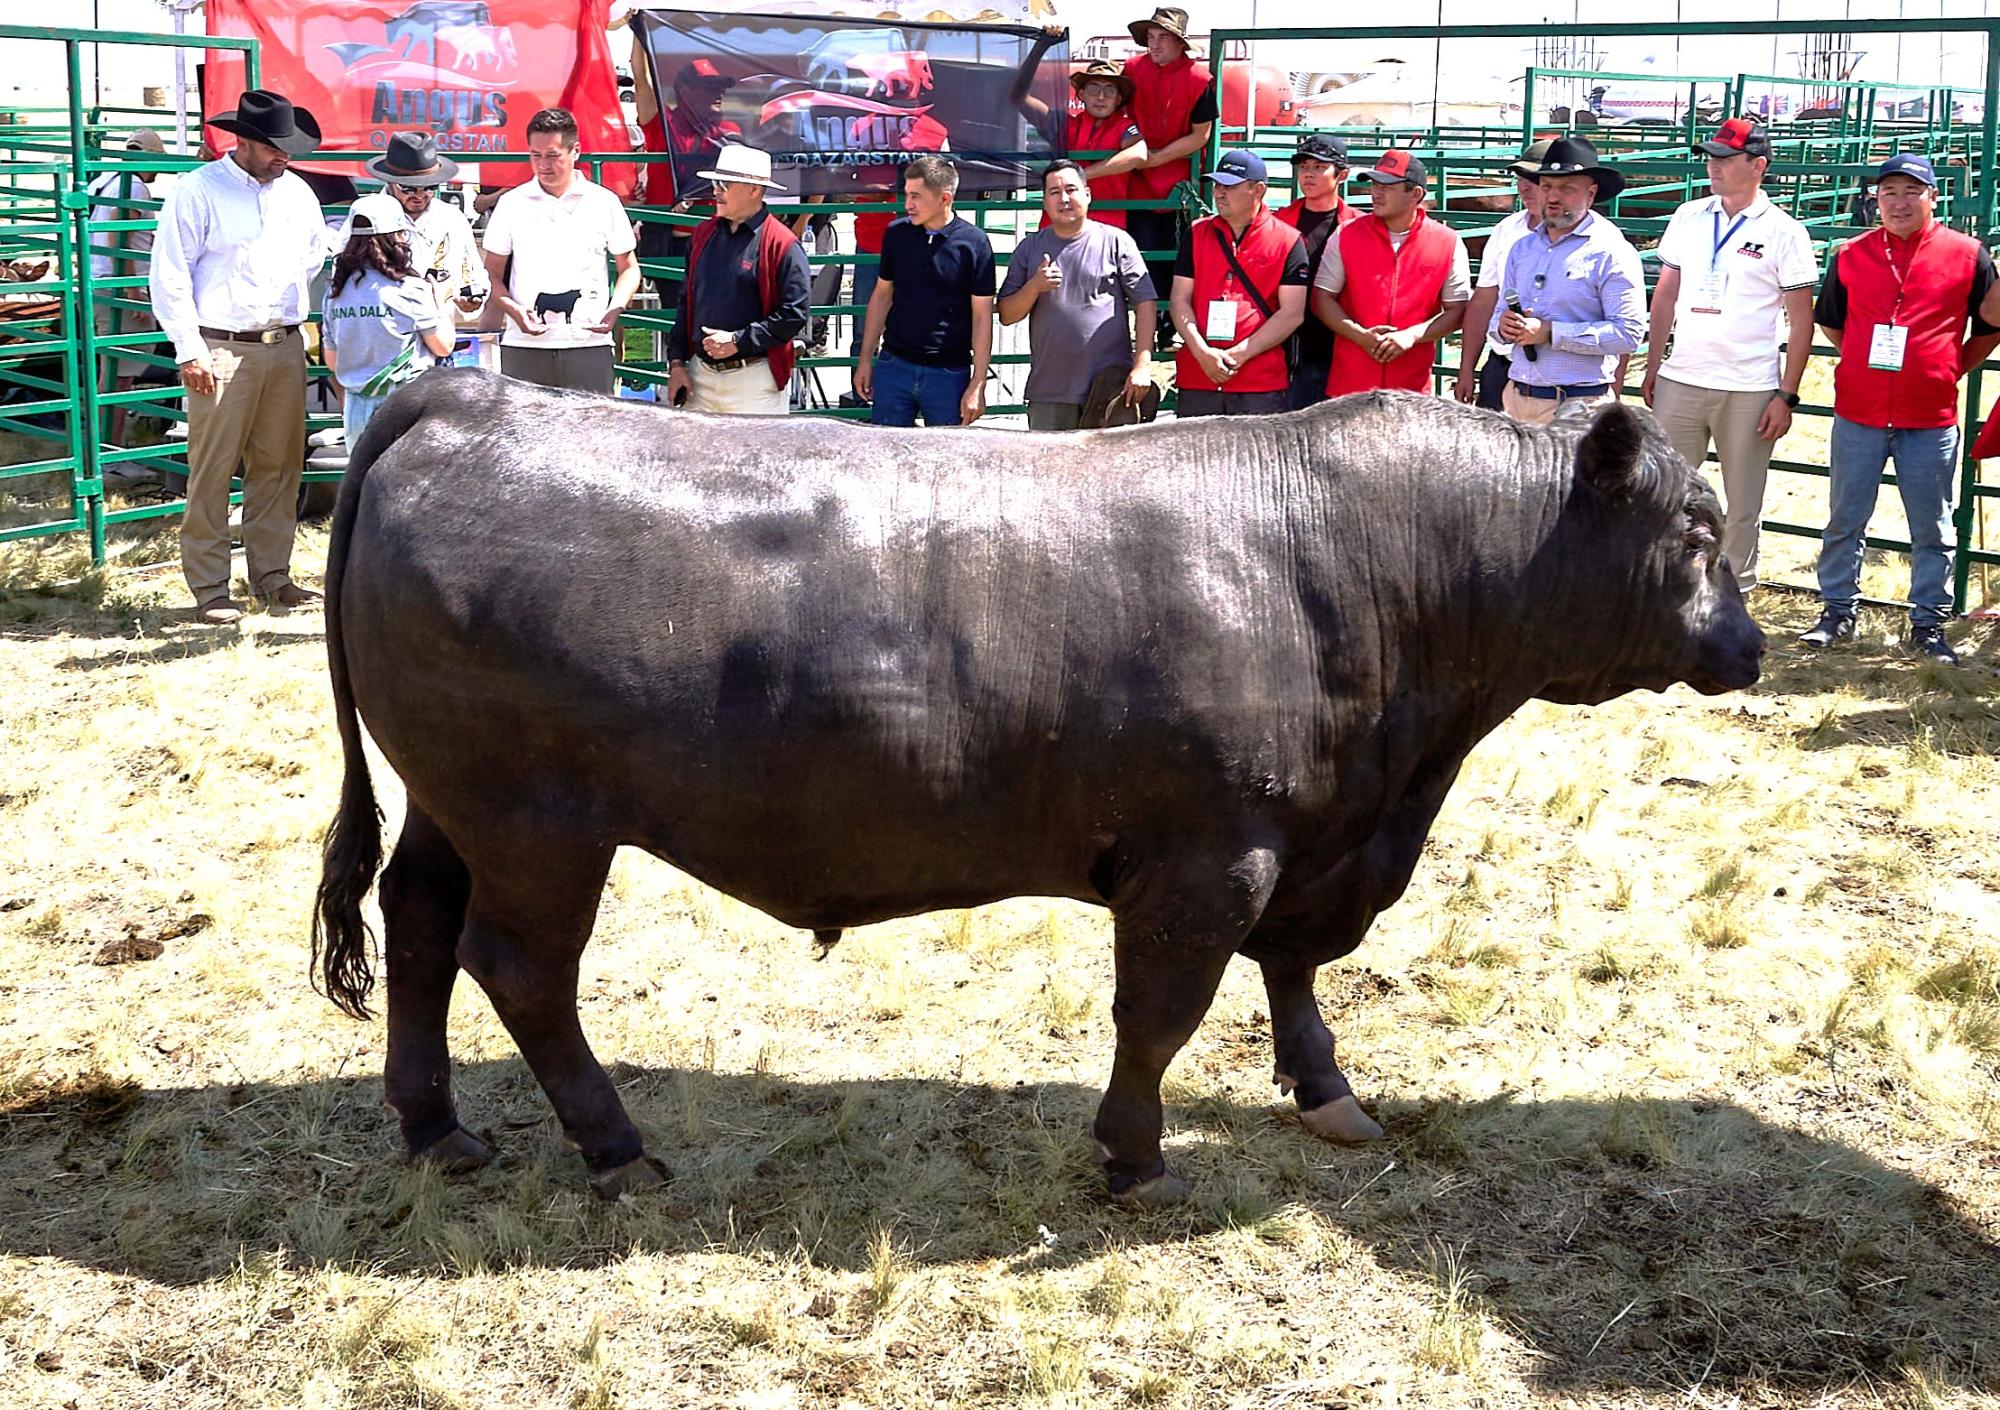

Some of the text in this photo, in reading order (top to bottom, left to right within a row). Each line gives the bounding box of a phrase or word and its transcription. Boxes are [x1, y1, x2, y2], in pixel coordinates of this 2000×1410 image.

[371, 80, 507, 131] Angus
[370, 130, 507, 152] QQSTAN
[360, 305, 394, 318] DALA
